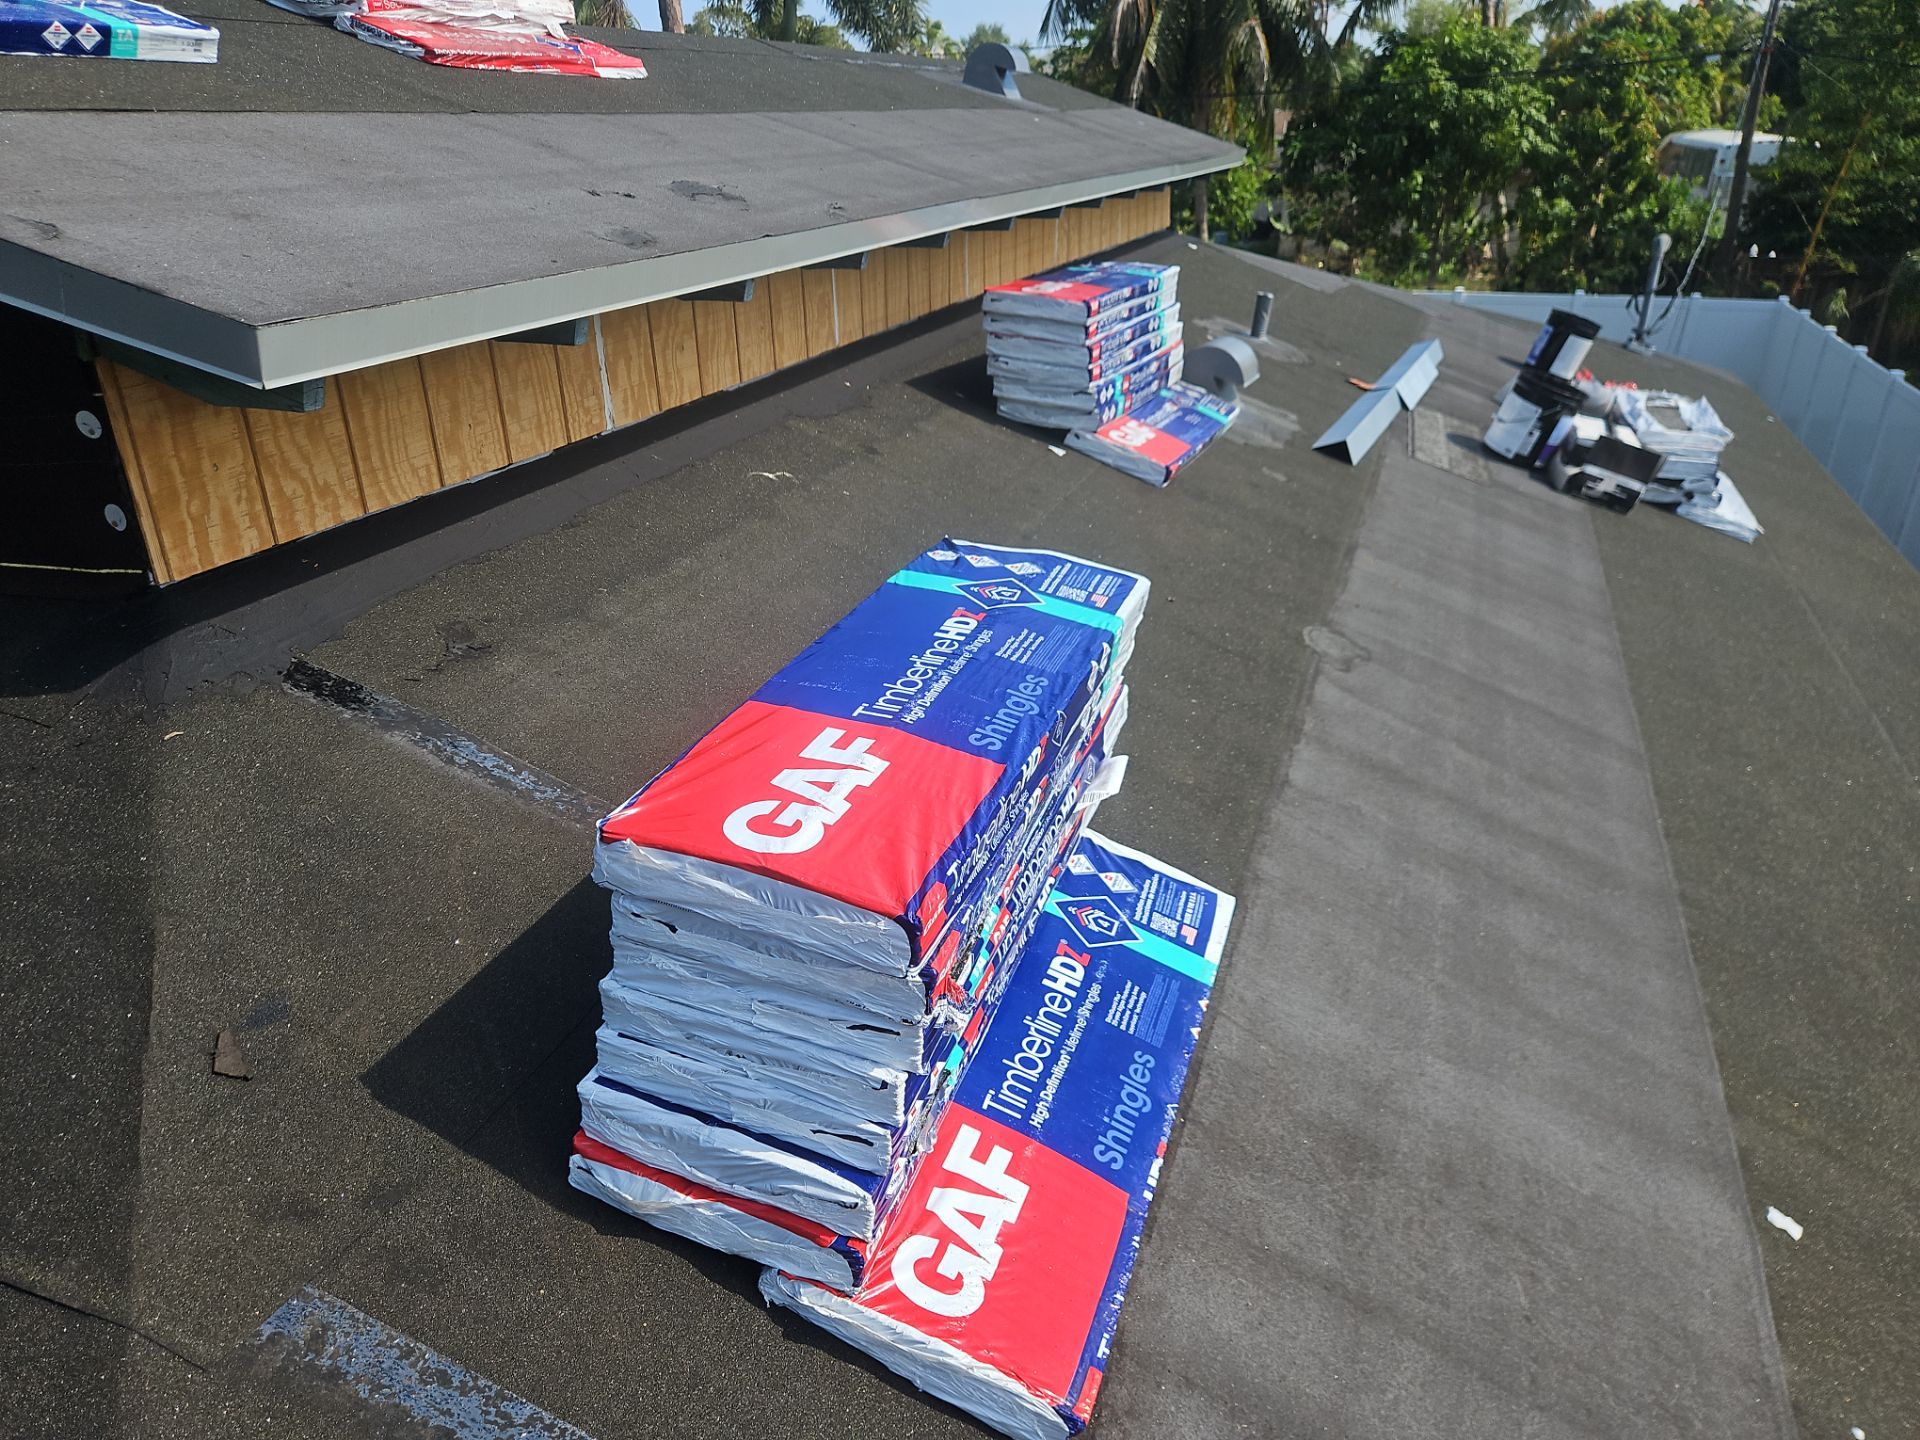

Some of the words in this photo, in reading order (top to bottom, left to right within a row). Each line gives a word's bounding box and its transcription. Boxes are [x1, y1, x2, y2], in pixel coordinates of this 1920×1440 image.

[901, 703, 926, 725] High
[970, 629, 994, 654] Shingles
[968, 674, 1049, 752] Shingles
[722, 727, 892, 855] GAF
[1029, 1101, 1051, 1129] High
[1078, 982, 1102, 1018] Shingles
[1093, 1049, 1156, 1171] Shingles
[891, 1124, 1030, 1317] GAF
